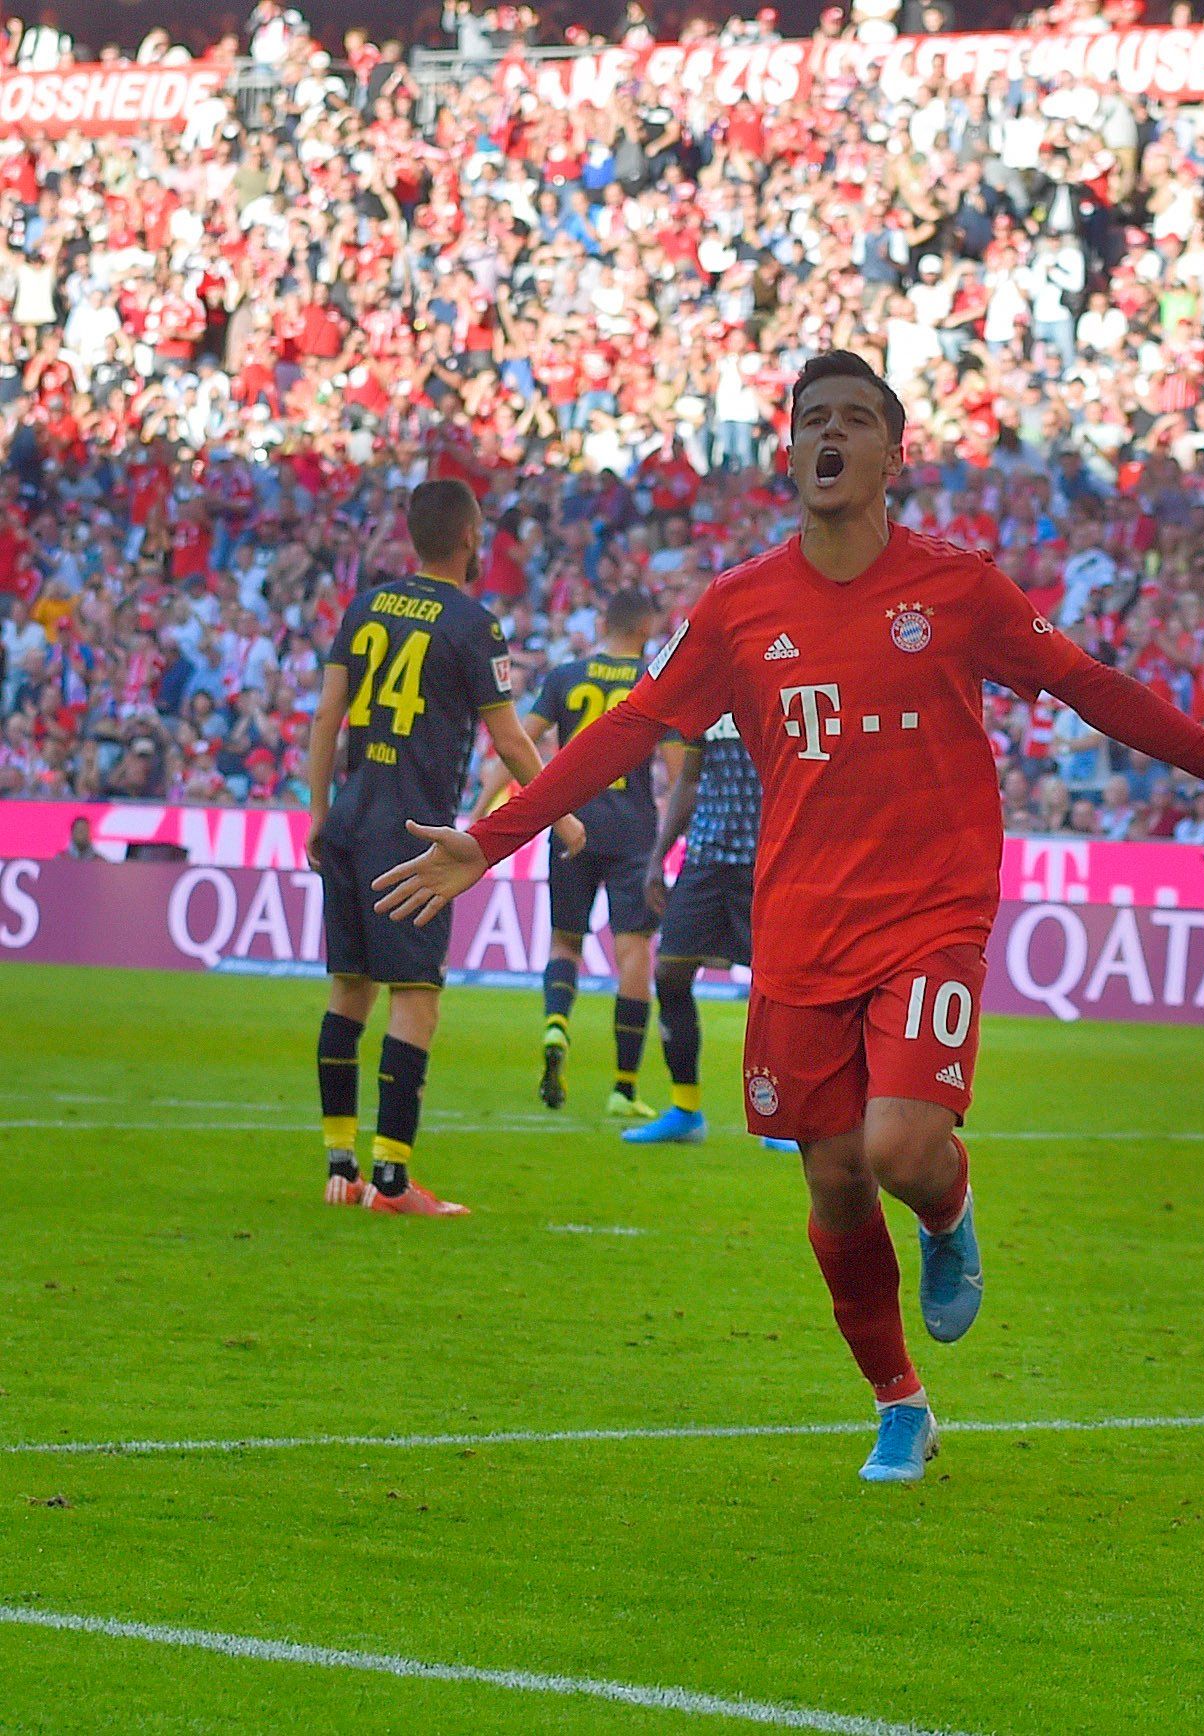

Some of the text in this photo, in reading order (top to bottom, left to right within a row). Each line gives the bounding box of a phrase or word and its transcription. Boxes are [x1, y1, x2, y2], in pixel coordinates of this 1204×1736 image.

[371, 591, 443, 623] DREXLER
[350, 621, 431, 737] 24
[764, 648, 800, 661] adidas
[904, 975, 972, 1048] 10
